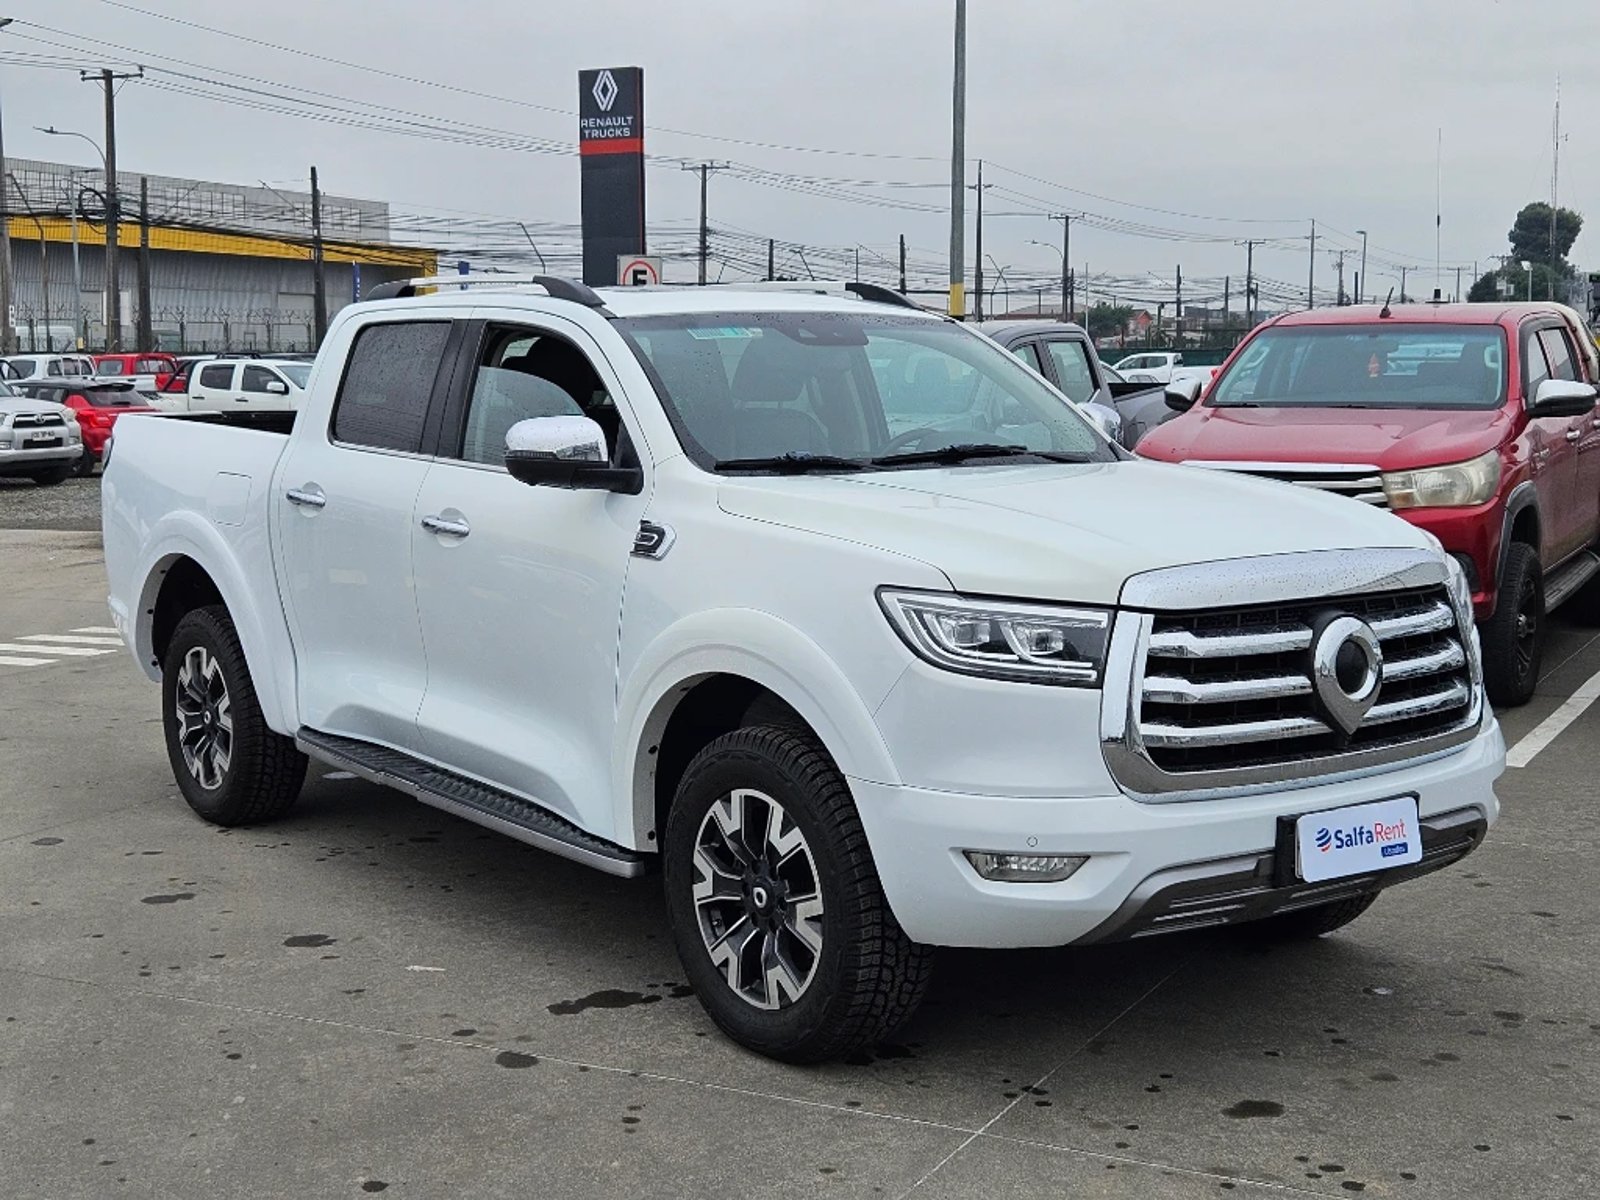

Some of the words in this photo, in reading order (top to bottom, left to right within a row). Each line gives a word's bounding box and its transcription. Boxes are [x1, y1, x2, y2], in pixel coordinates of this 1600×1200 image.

[581, 116, 634, 128] RENAULT
[584, 127, 631, 139] TRUCKS
[1334, 818, 1407, 849] SalfaRent
